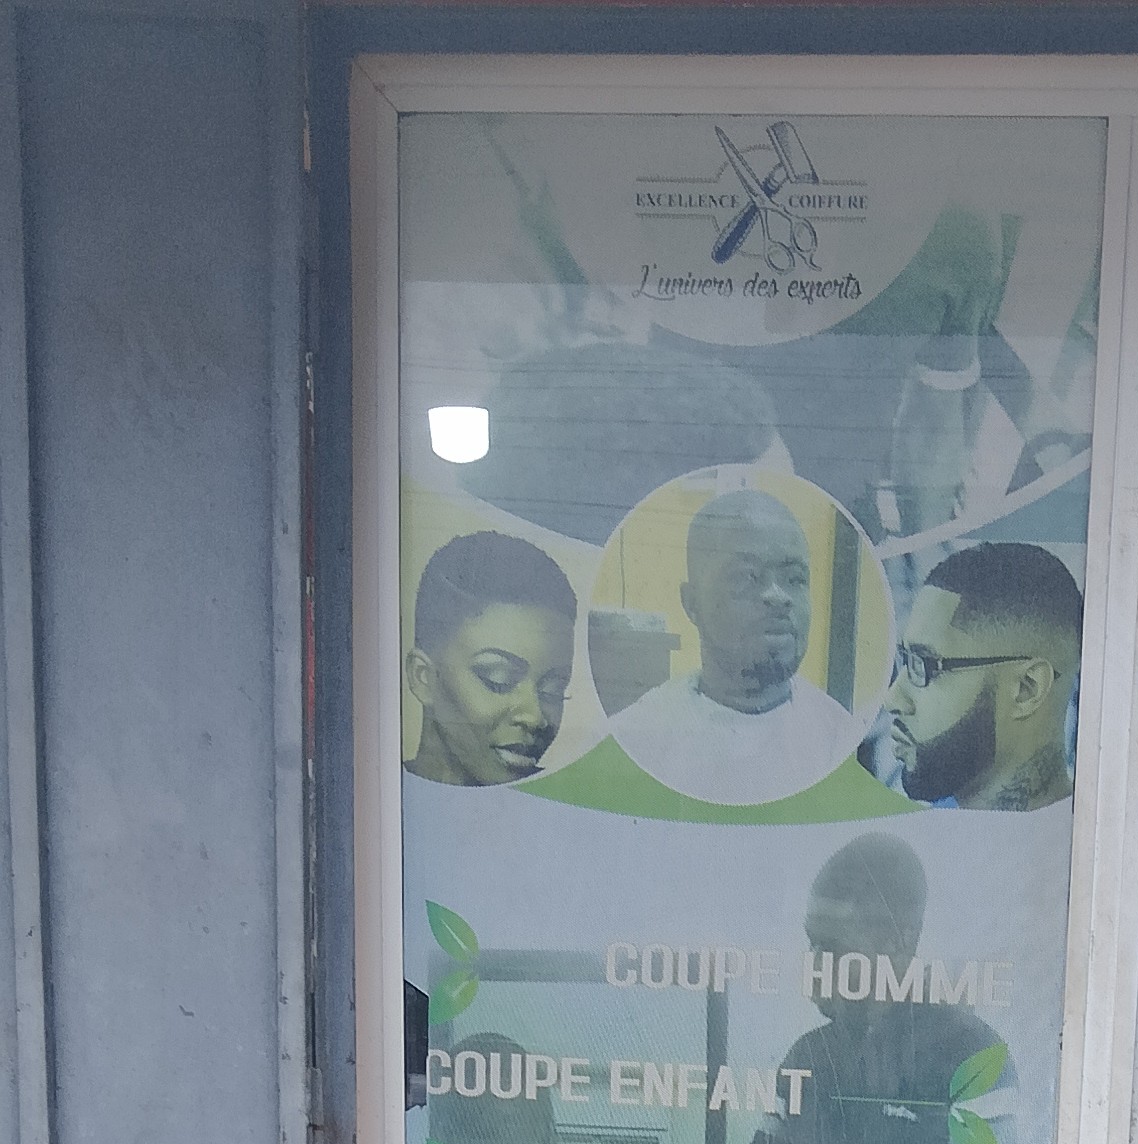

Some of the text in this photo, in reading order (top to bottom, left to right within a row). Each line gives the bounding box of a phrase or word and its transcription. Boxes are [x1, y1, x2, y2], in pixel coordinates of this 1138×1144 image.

[635, 193, 868, 210] EXCELLENCE COIFFURE
[632, 264, 862, 305] L'univers des experts
[604, 940, 1016, 1009] COUPE HOMME
[425, 1048, 813, 1117] COUPE ENFANT
